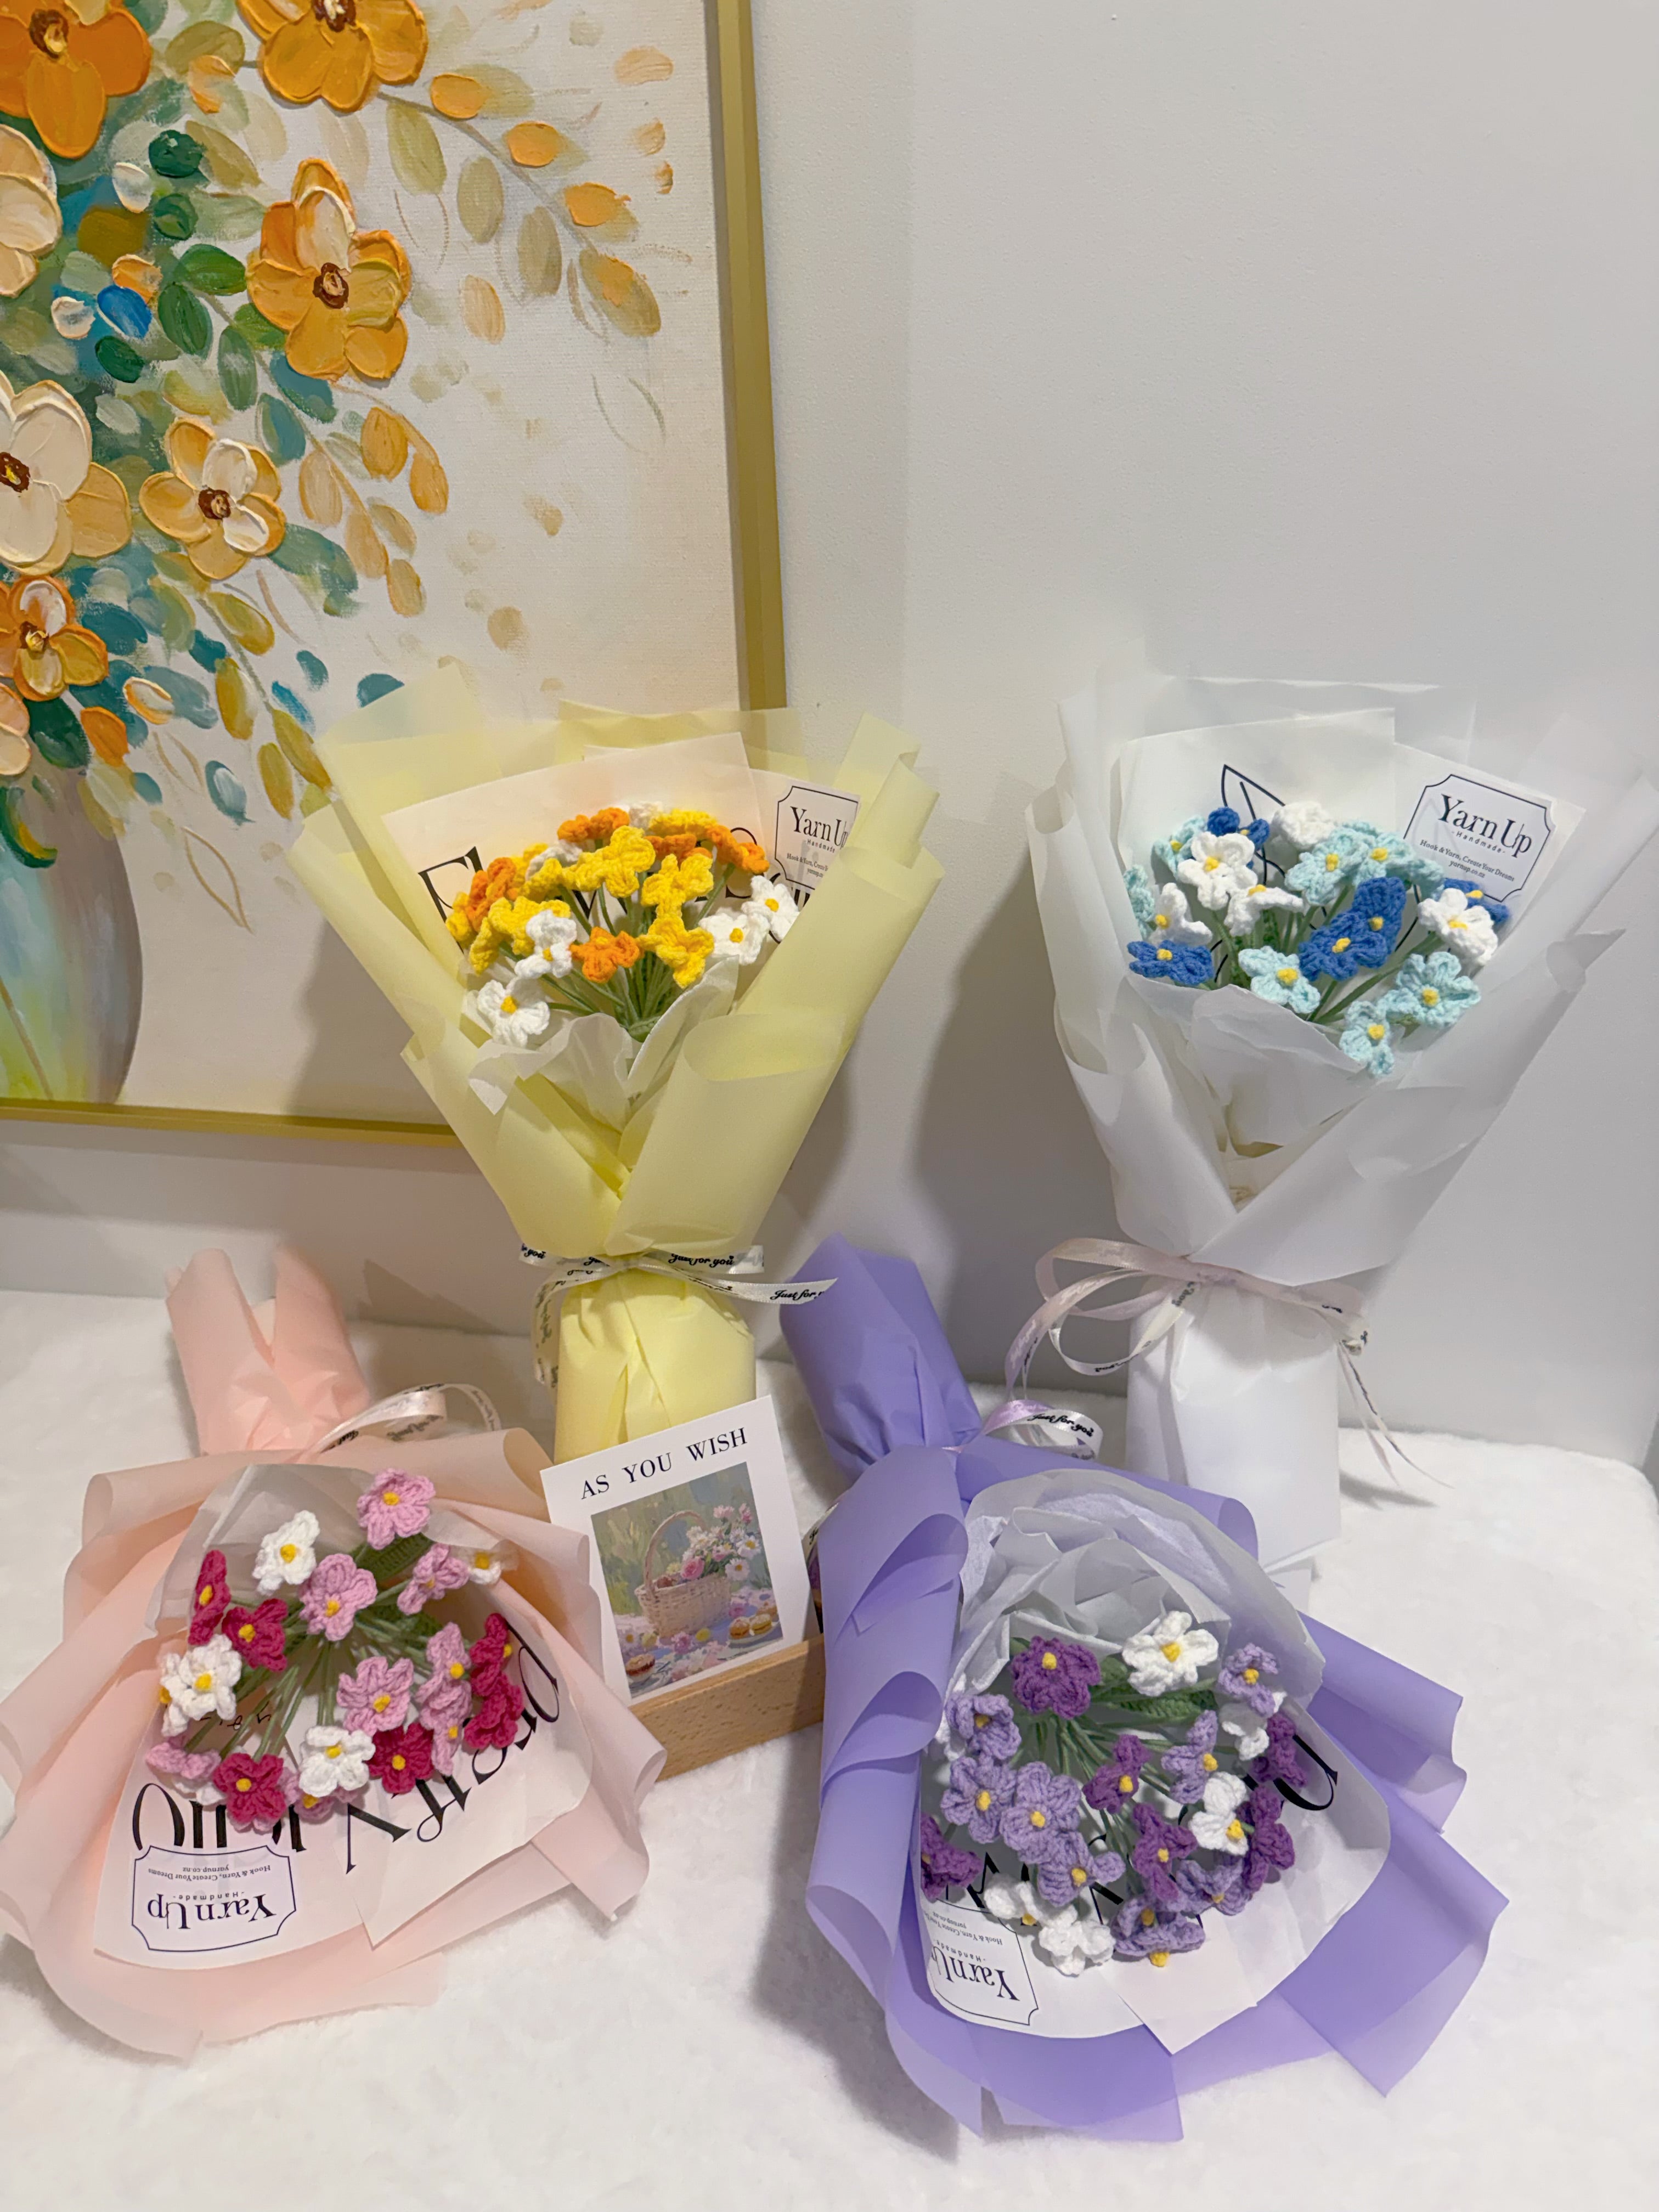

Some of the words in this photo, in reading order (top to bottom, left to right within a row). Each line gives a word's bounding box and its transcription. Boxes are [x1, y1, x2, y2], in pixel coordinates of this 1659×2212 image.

[1420, 839, 1438, 852] Hook
[1444, 848, 1462, 861] Yarn,
[1462, 855, 1481, 869] Create
[1481, 863, 1496, 874] Your
[1496, 868, 1515, 882] Dreams
[1448, 860, 1485, 878] yarnup.co.nz
[709, 1255, 734, 1267] you
[770, 1290, 795, 1300] Just
[795, 1289, 816, 1300] for
[1027, 1413, 1056, 1423] Just
[1052, 1415, 1074, 1425] for
[1071, 1424, 1094, 1437] you
[581, 1474, 610, 1500] AS
[622, 1452, 672, 1483] YOU
[686, 1427, 748, 1462] WISH
[148, 1868, 173, 1880] Dreams
[183, 1864, 229, 1872] yarnup.co.nz
[250, 1865, 270, 1875] Hook
[175, 1874, 192, 1882] Your
[985, 1936, 1003, 1945] Hook
